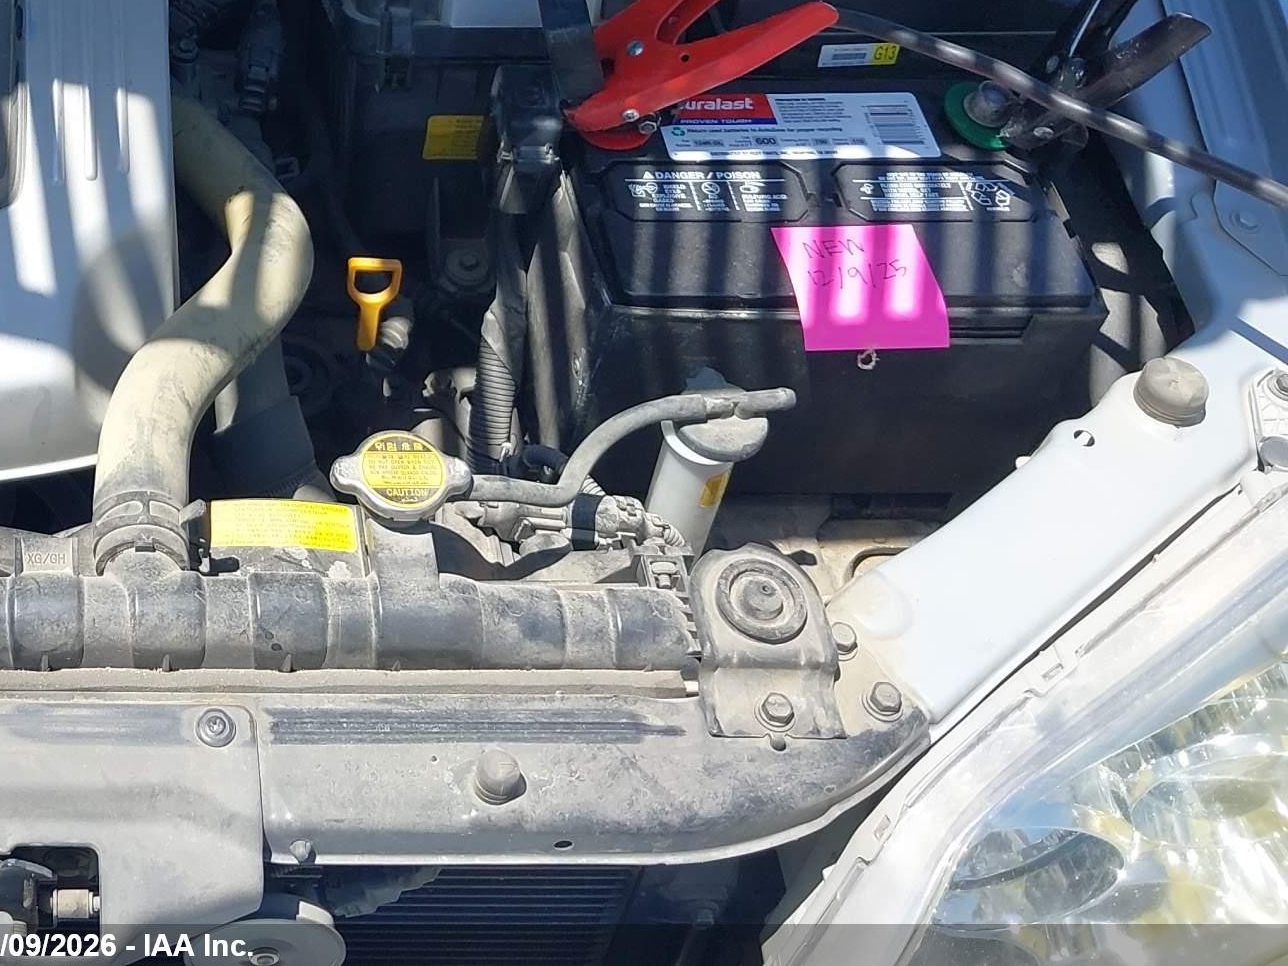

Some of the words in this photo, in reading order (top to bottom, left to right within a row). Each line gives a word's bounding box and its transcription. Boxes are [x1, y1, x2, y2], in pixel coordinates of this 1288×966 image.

[874, 45, 897, 61] G13
[680, 97, 754, 111] uralast
[755, 137, 777, 146] 600
[654, 171, 705, 180] DANGER
[716, 171, 761, 180] POISON
[385, 488, 429, 497] CAUTION
